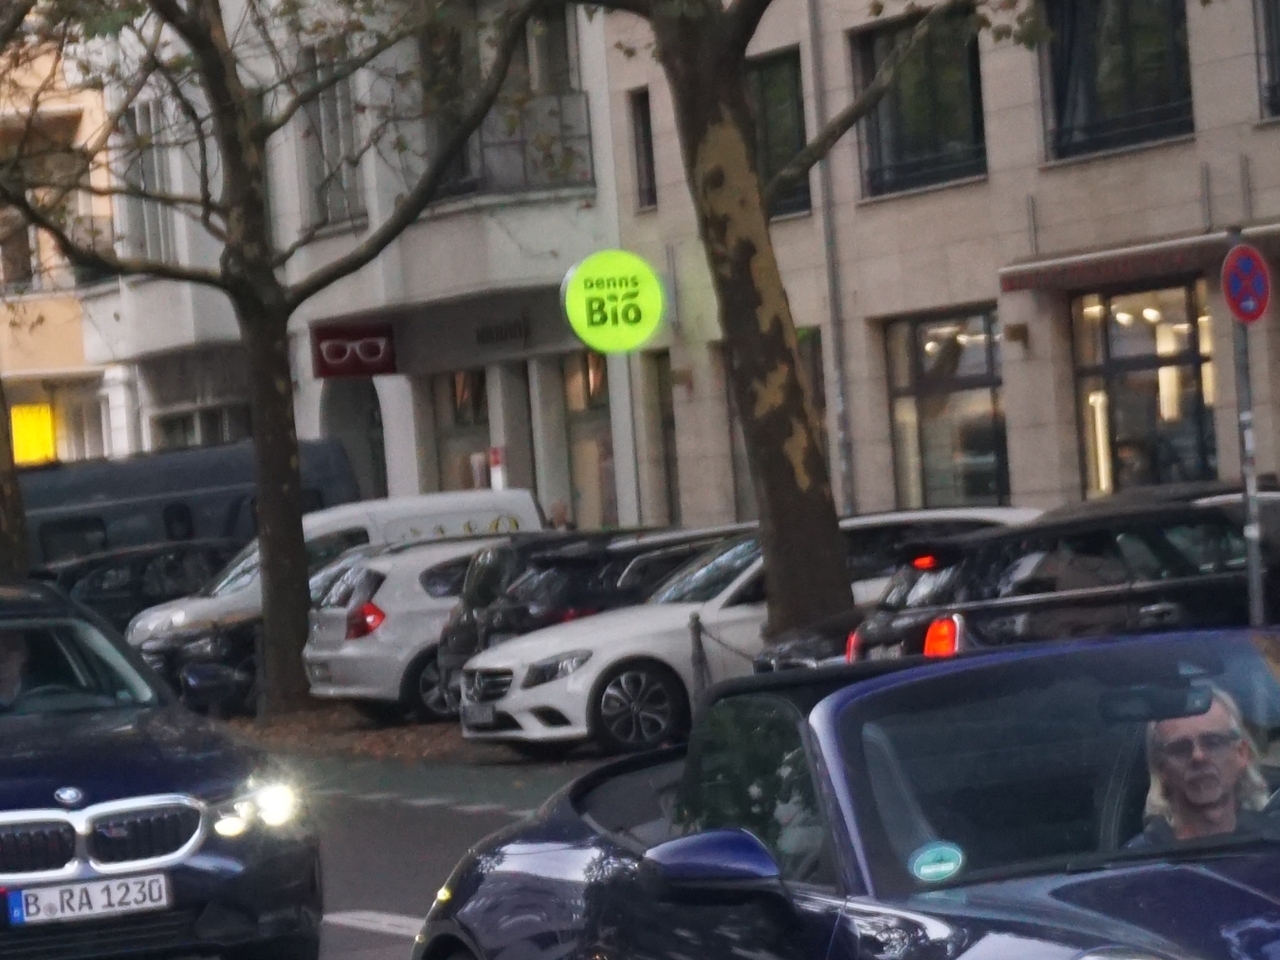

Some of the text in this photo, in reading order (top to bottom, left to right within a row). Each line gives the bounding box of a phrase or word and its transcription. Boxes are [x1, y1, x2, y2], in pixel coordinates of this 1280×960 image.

[24, 893, 41, 918] B
[58, 886, 94, 914] RA
[100, 878, 164, 909] 1230
